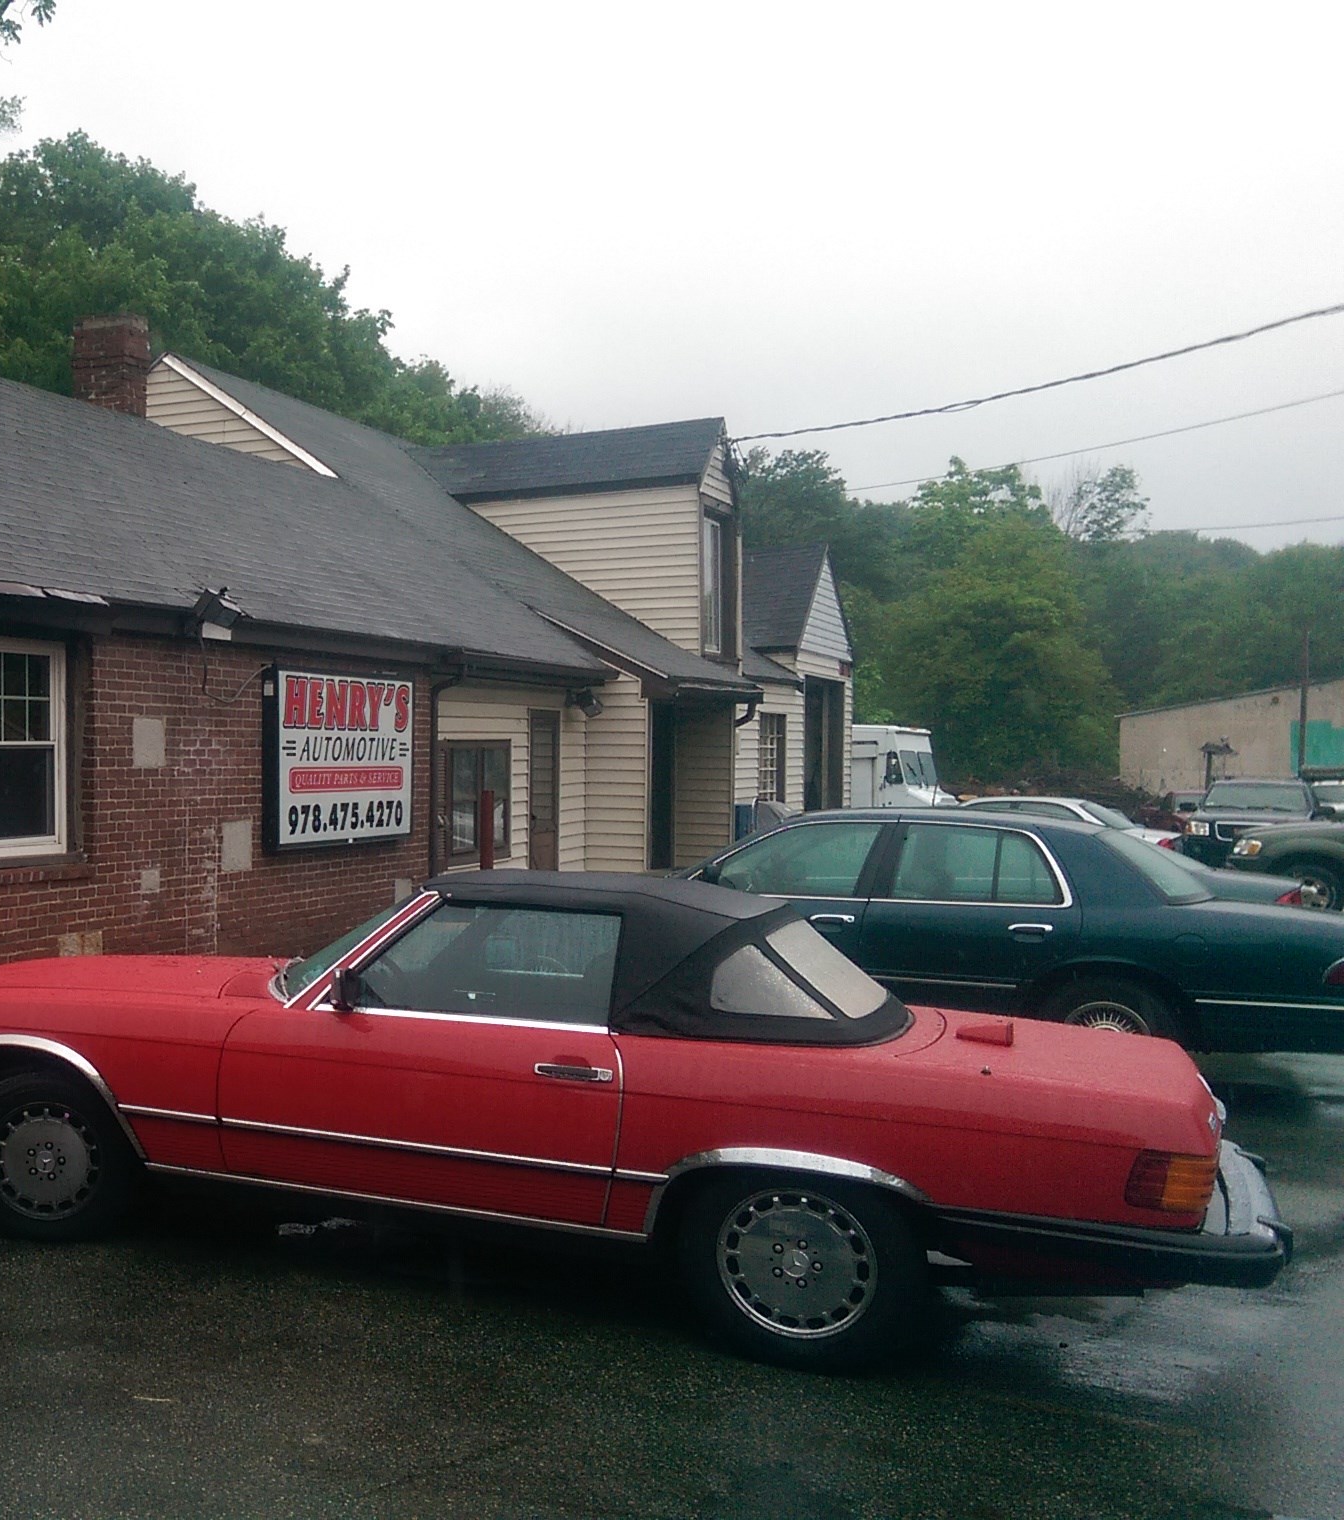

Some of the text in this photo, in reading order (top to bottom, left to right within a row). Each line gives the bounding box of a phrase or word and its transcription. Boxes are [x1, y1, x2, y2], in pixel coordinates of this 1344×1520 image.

[283, 675, 410, 733] HENRY'S
[299, 736, 397, 761] AUTOMOTIVE
[295, 772, 399, 788] QUALITY PARTS & SERVICE
[288, 800, 403, 835] 978.475.4270
